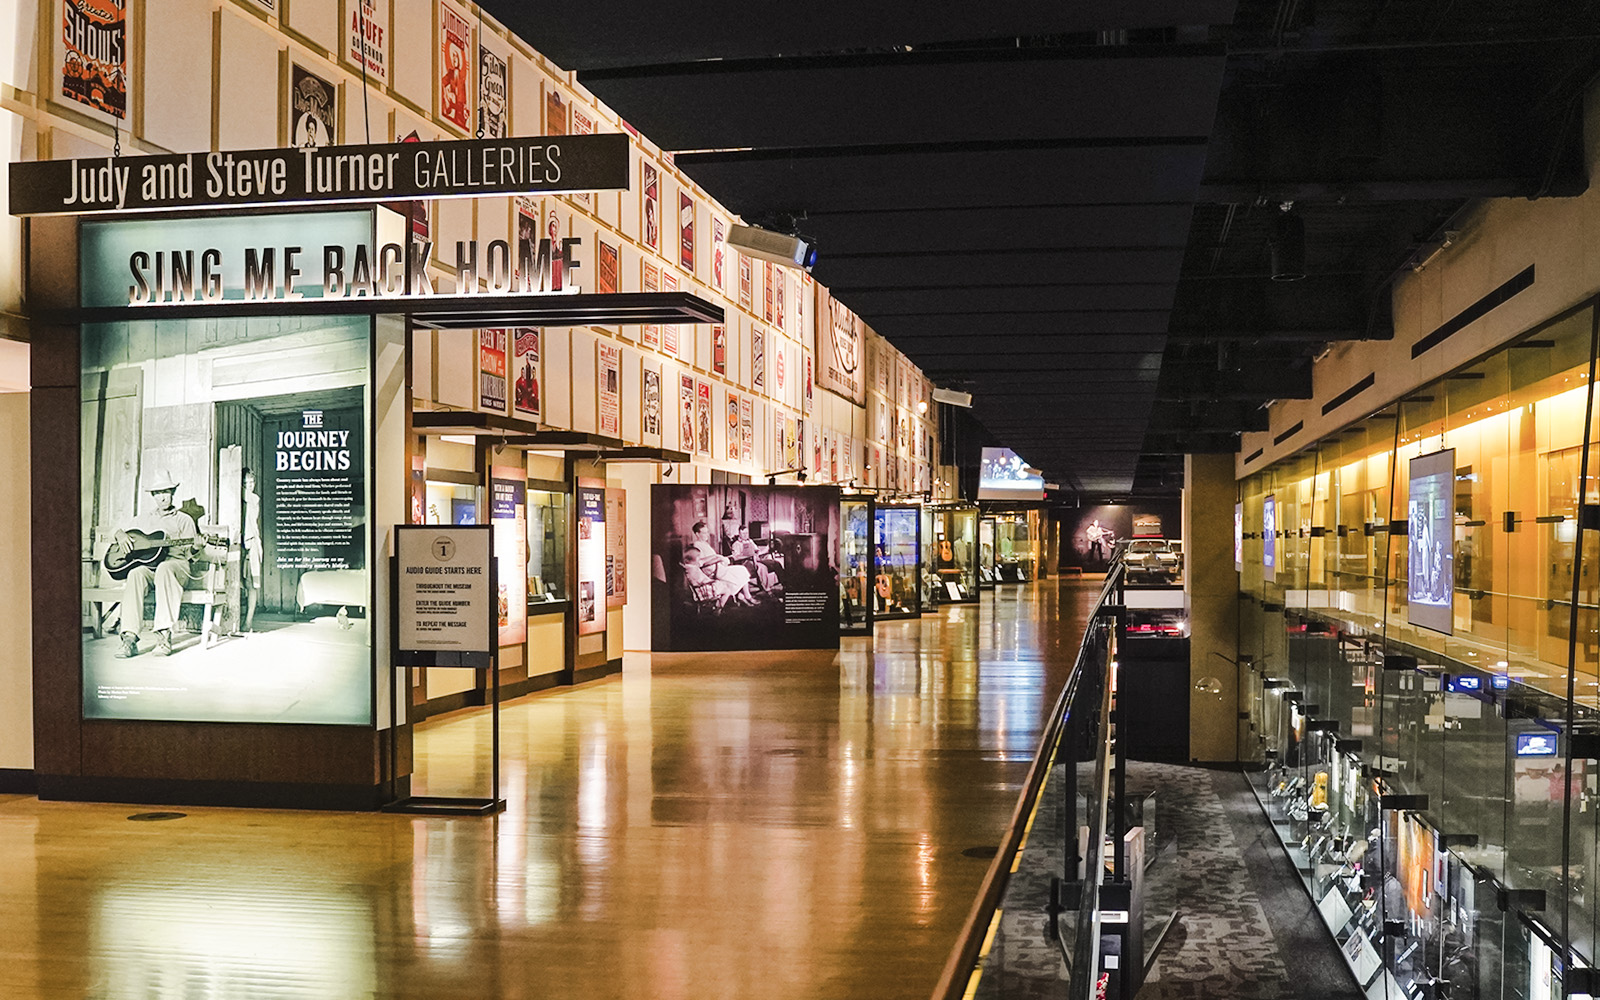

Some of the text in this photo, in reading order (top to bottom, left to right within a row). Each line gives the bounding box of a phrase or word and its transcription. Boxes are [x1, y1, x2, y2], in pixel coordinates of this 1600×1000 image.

[64, 1, 121, 66] SHOWS
[352, 10, 384, 49] ACUFF
[352, 35, 383, 64] GOERNOR
[380, 67, 386, 78] 2
[63, 144, 562, 210] Judy and Steve Turner GALLERIES
[128, 249, 224, 305] SING
[244, 245, 304, 301] ME
[322, 241, 434, 299] BACK
[455, 237, 582, 296] HOME
[481, 349, 498, 373] SHOW
[303, 414, 323, 425] THE
[276, 430, 350, 449] JOURNEY
[275, 449, 351, 471] BEGINS
[440, 545, 446, 557] 1
[406, 566, 482, 575] AUDIO GUIDE STARTS HERE
